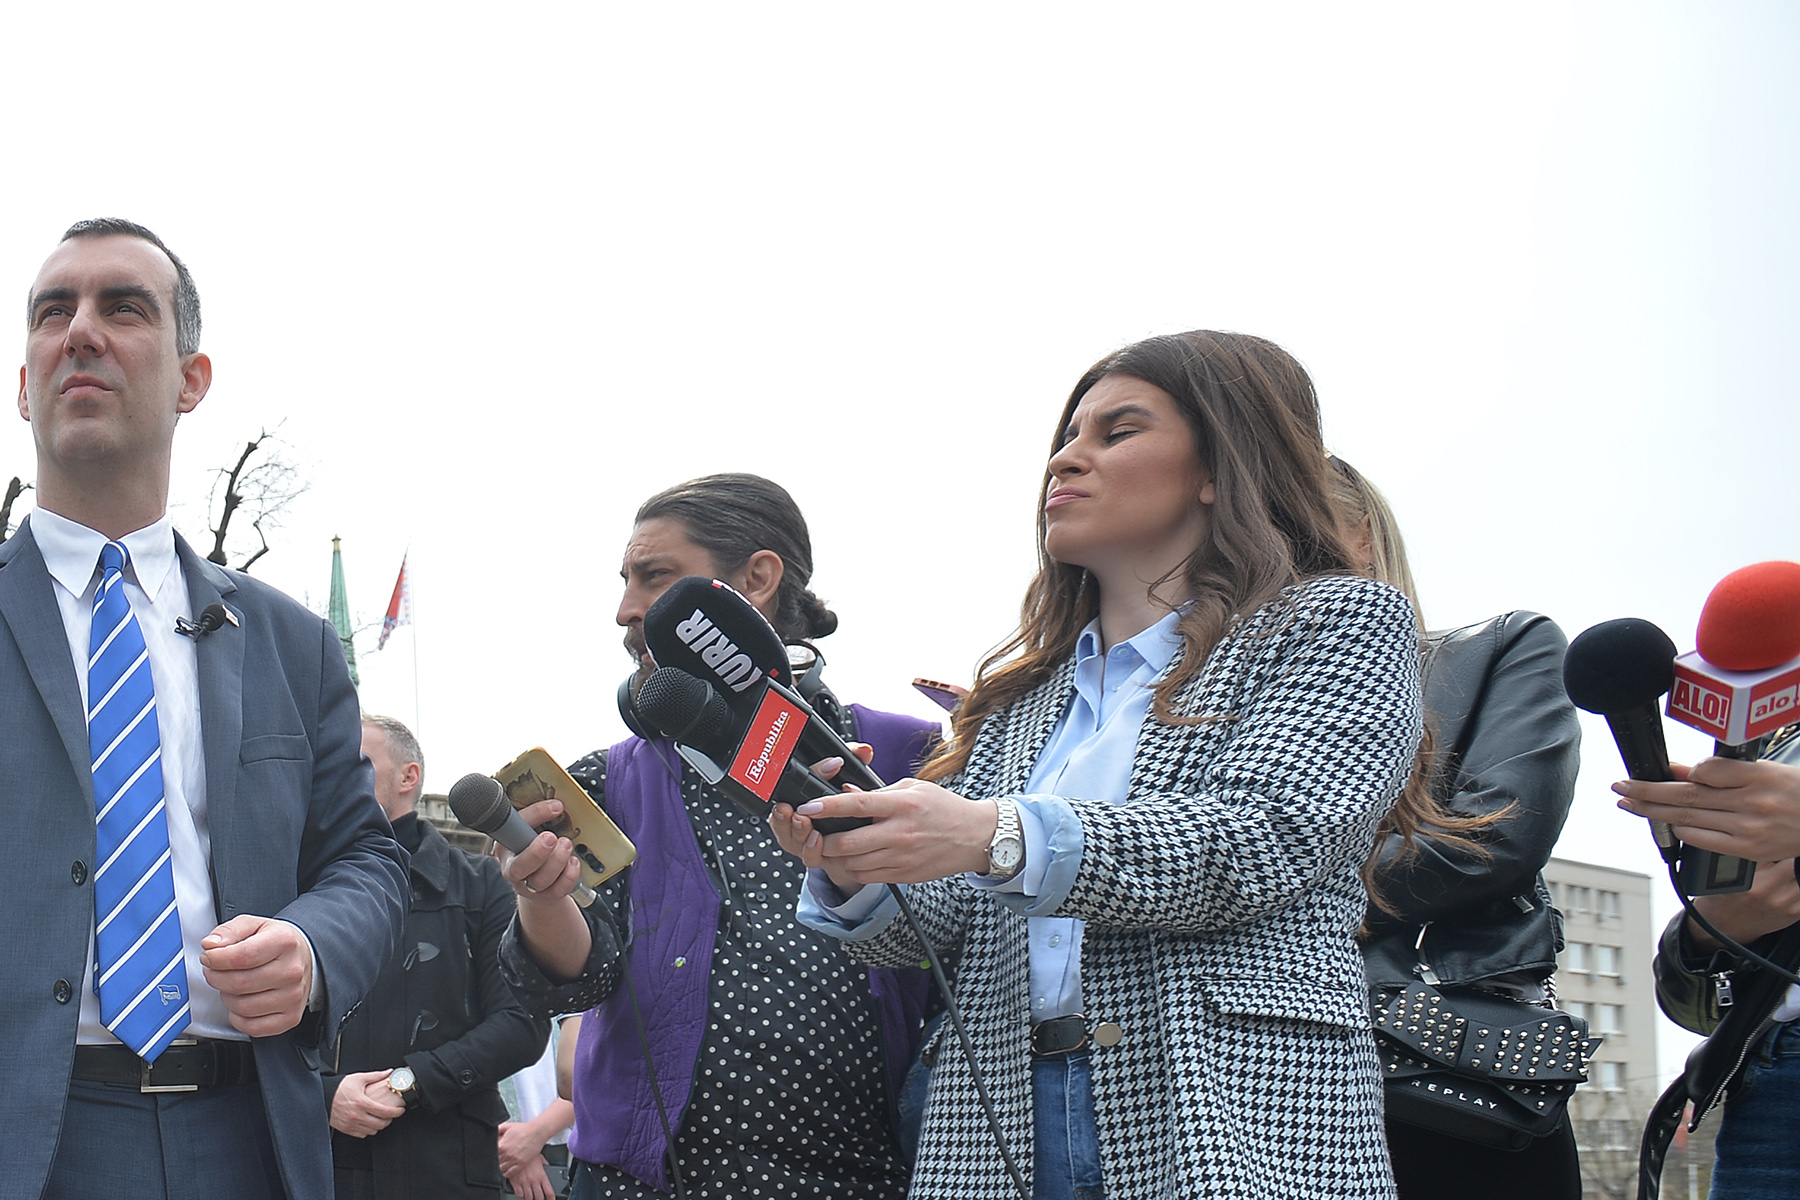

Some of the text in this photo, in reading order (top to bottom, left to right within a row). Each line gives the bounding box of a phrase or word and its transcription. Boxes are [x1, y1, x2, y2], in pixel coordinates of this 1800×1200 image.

[675, 608, 763, 693] KURIR
[1674, 681, 1727, 725] ALO!
[748, 711, 789, 779] Republika
[1411, 1080, 1497, 1109] REPLAY
